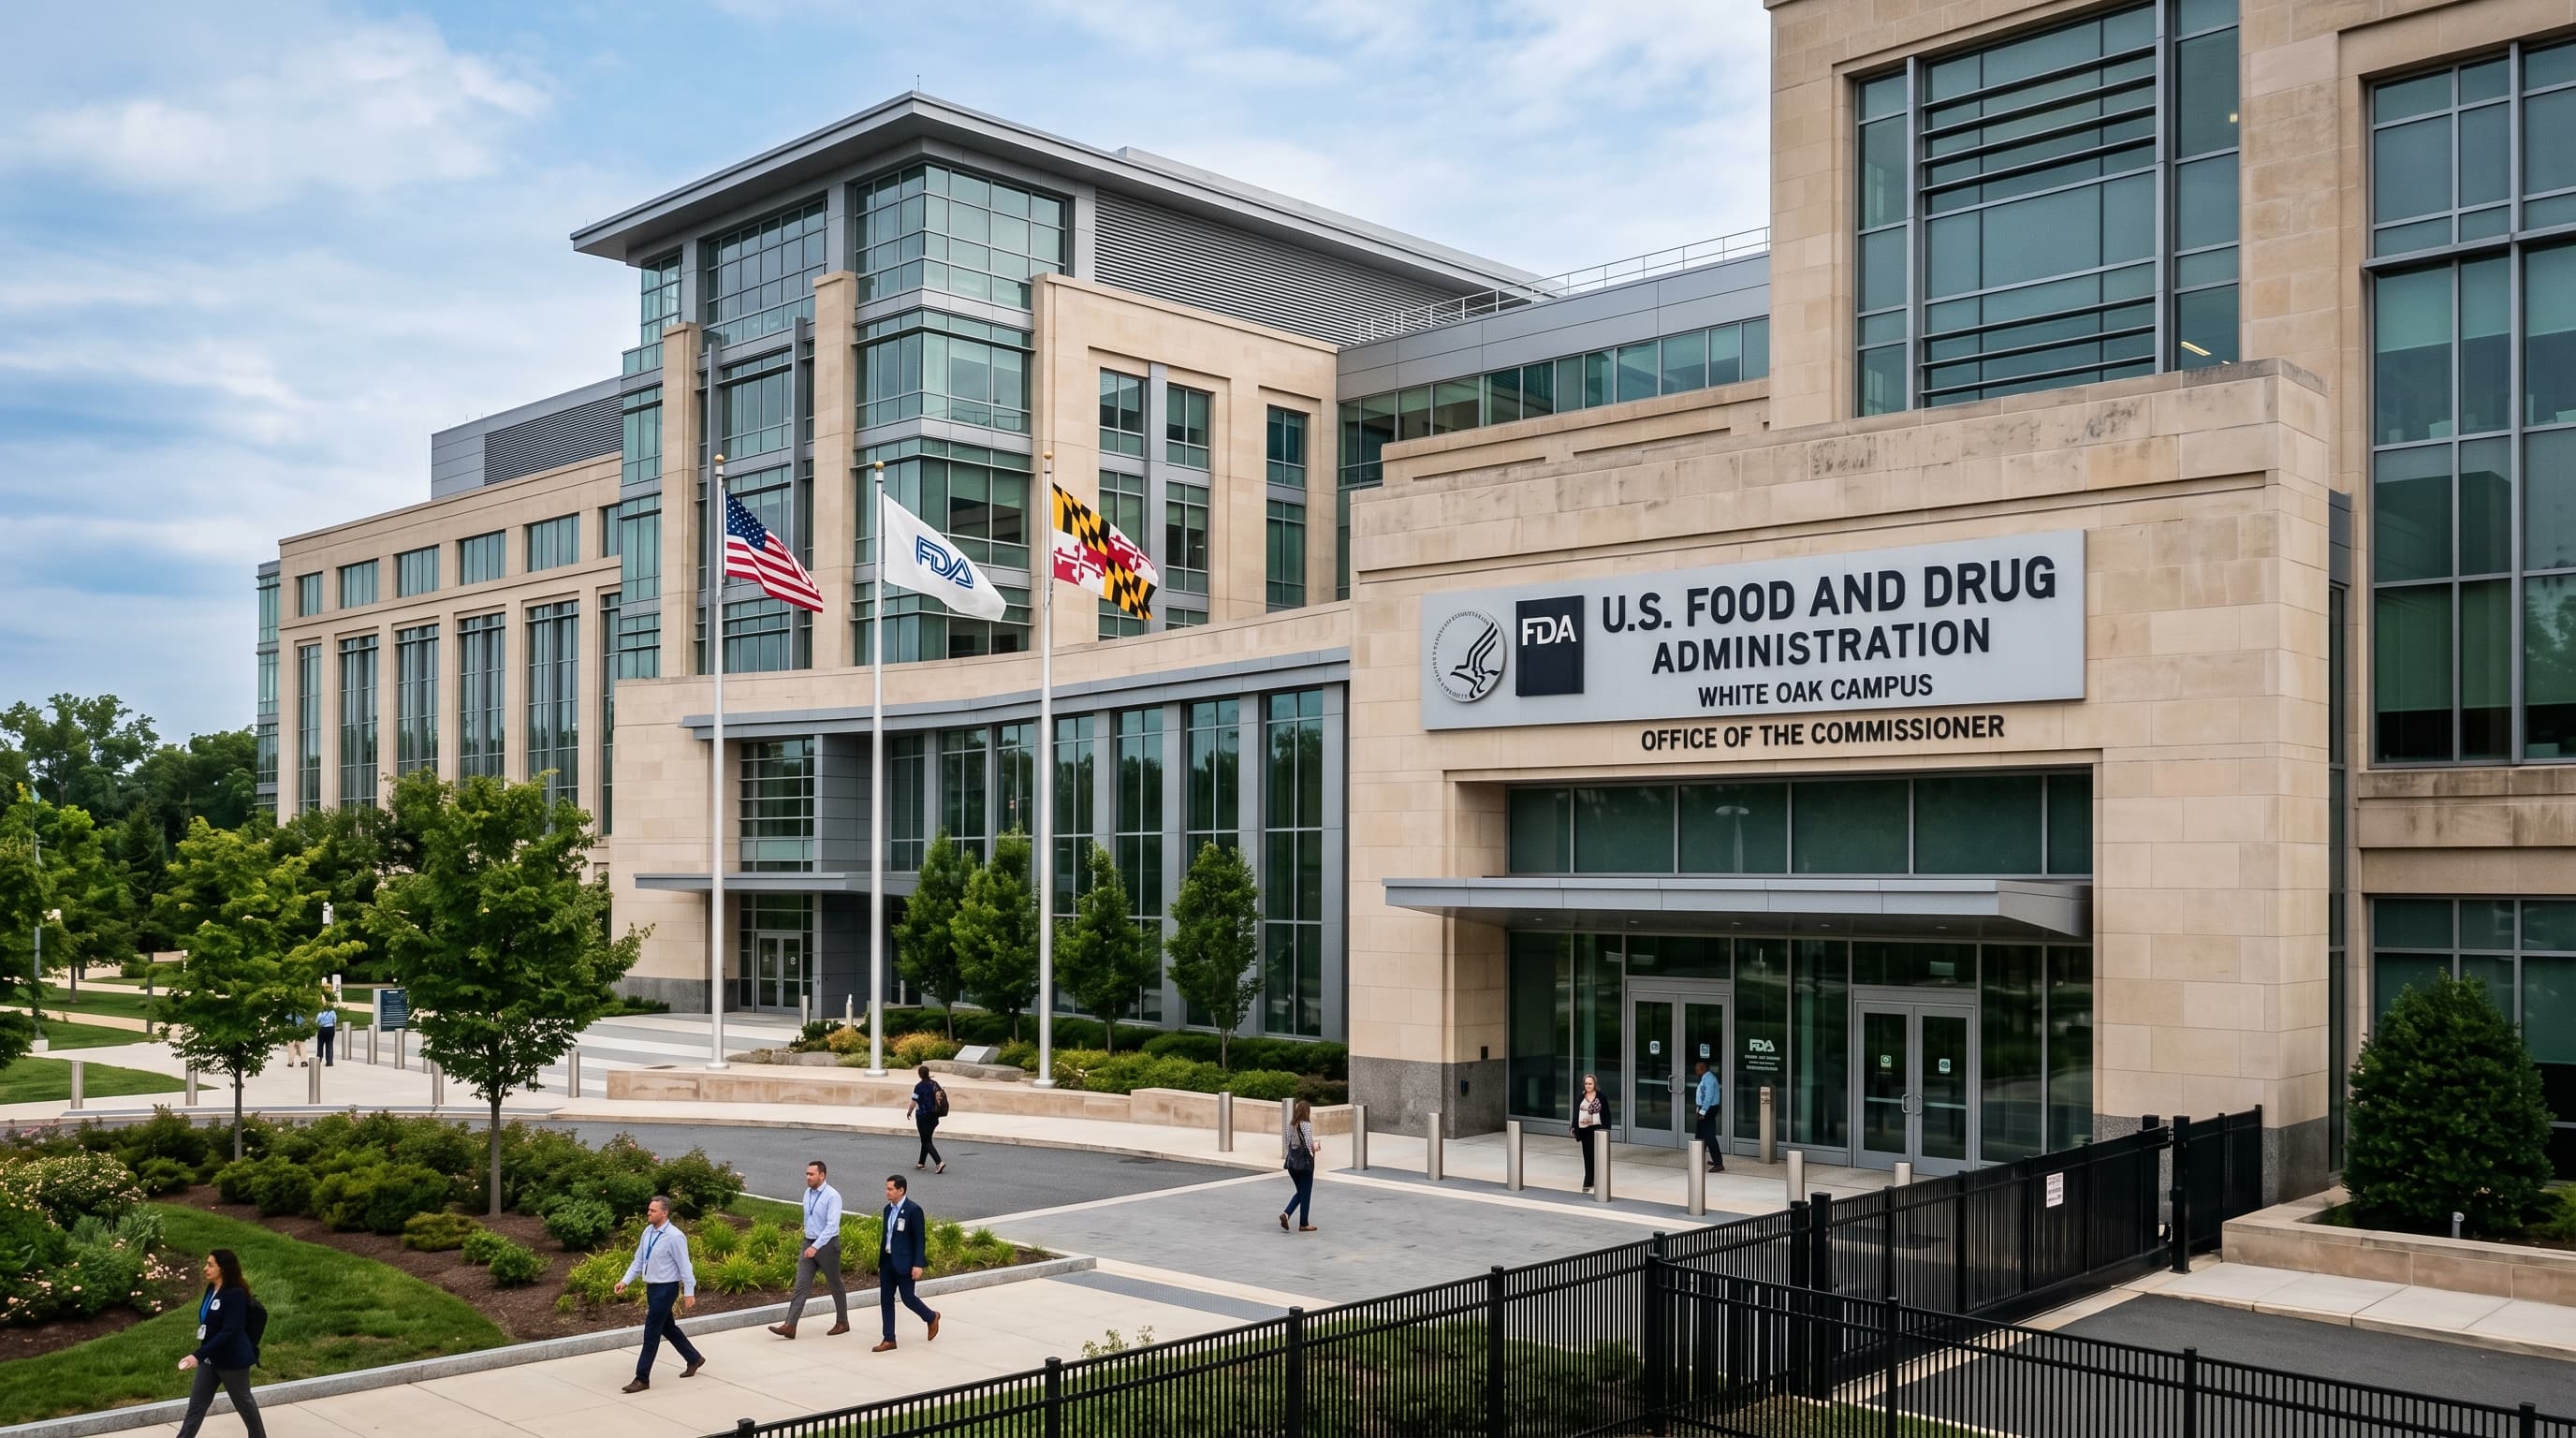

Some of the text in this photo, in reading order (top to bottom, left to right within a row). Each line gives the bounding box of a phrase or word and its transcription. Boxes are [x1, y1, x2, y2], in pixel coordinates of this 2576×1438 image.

[915, 535, 974, 590] FDA
[1603, 555, 2056, 635] U.S. FOOD AND DRUG
[1521, 614, 1577, 646] FDA
[1651, 617, 1990, 675] ADMINISTRATION
[1697, 673, 1933, 708] WHITE OAK CAMPUS
[1641, 714, 2005, 751] OFFICE OF THE COMMISSIONER
[1749, 1038, 1776, 1052] FDA
